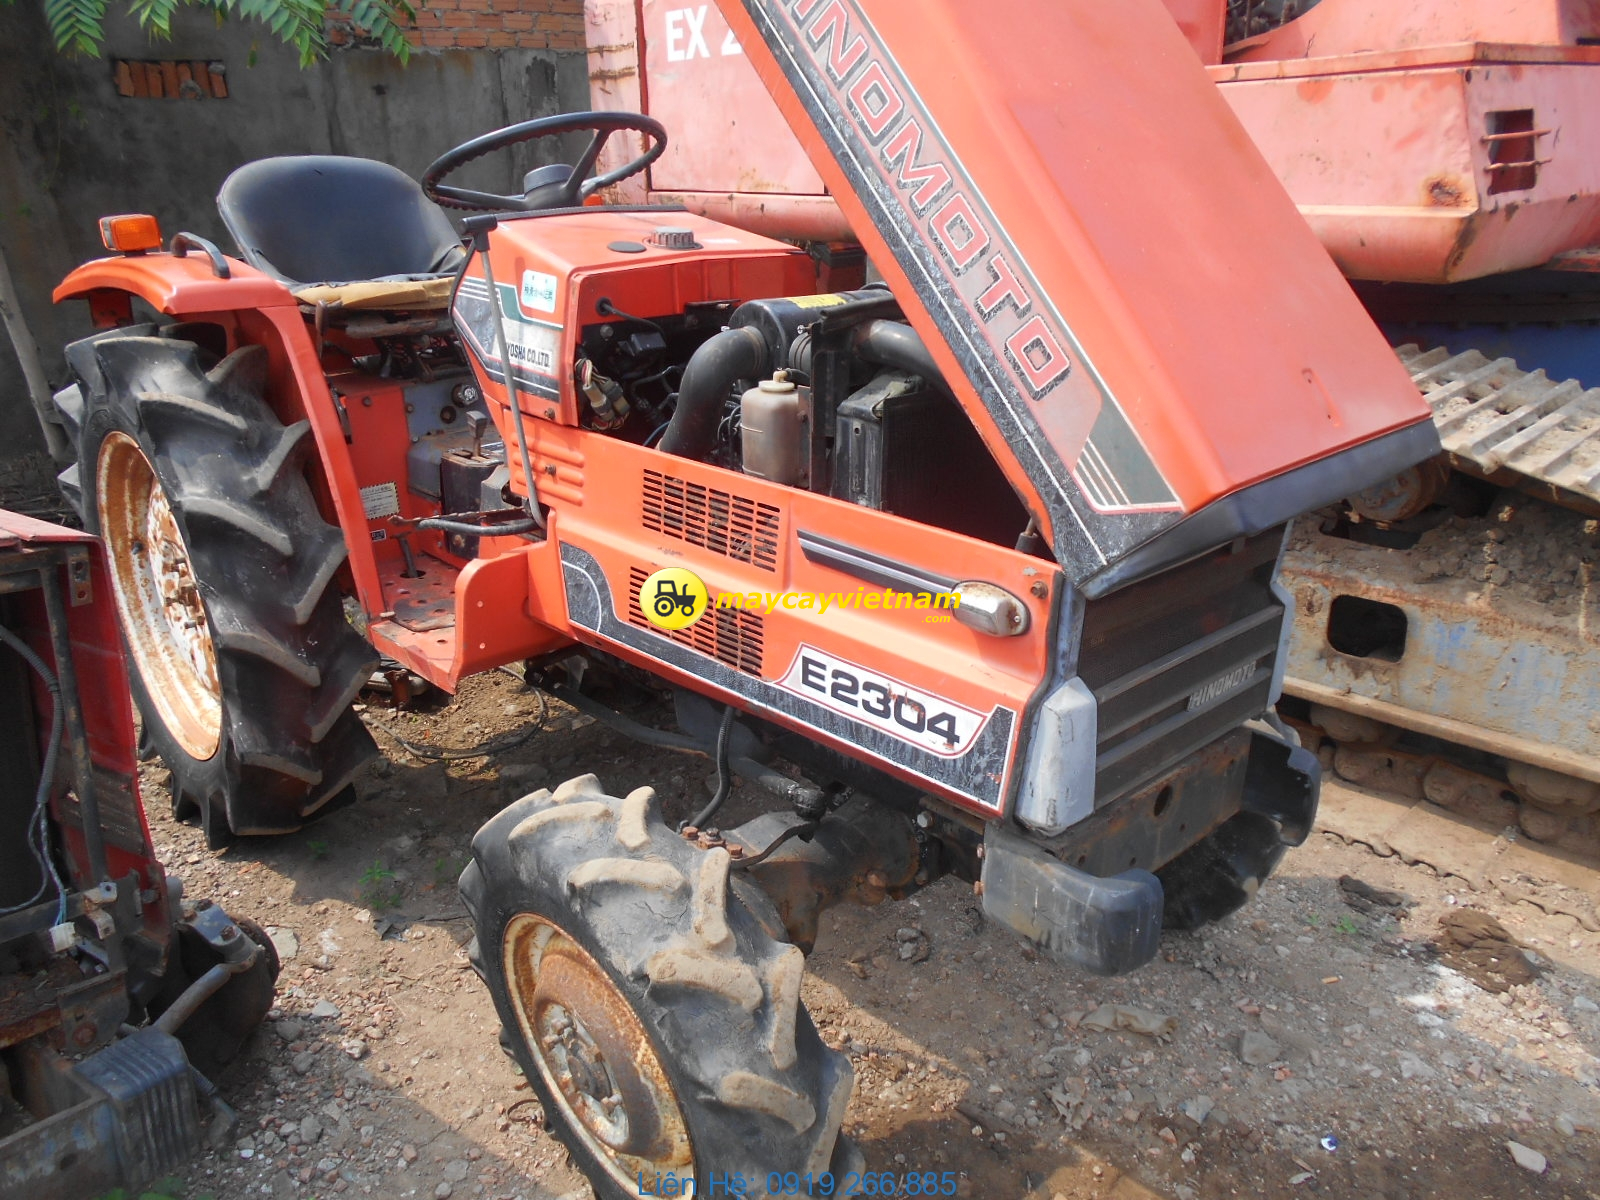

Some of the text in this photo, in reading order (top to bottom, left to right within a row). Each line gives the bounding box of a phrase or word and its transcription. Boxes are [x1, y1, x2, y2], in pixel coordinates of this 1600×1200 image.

[665, 5, 710, 62] EX
[802, 655, 960, 745] E2304
[1187, 660, 1257, 712] HINOMOTO
